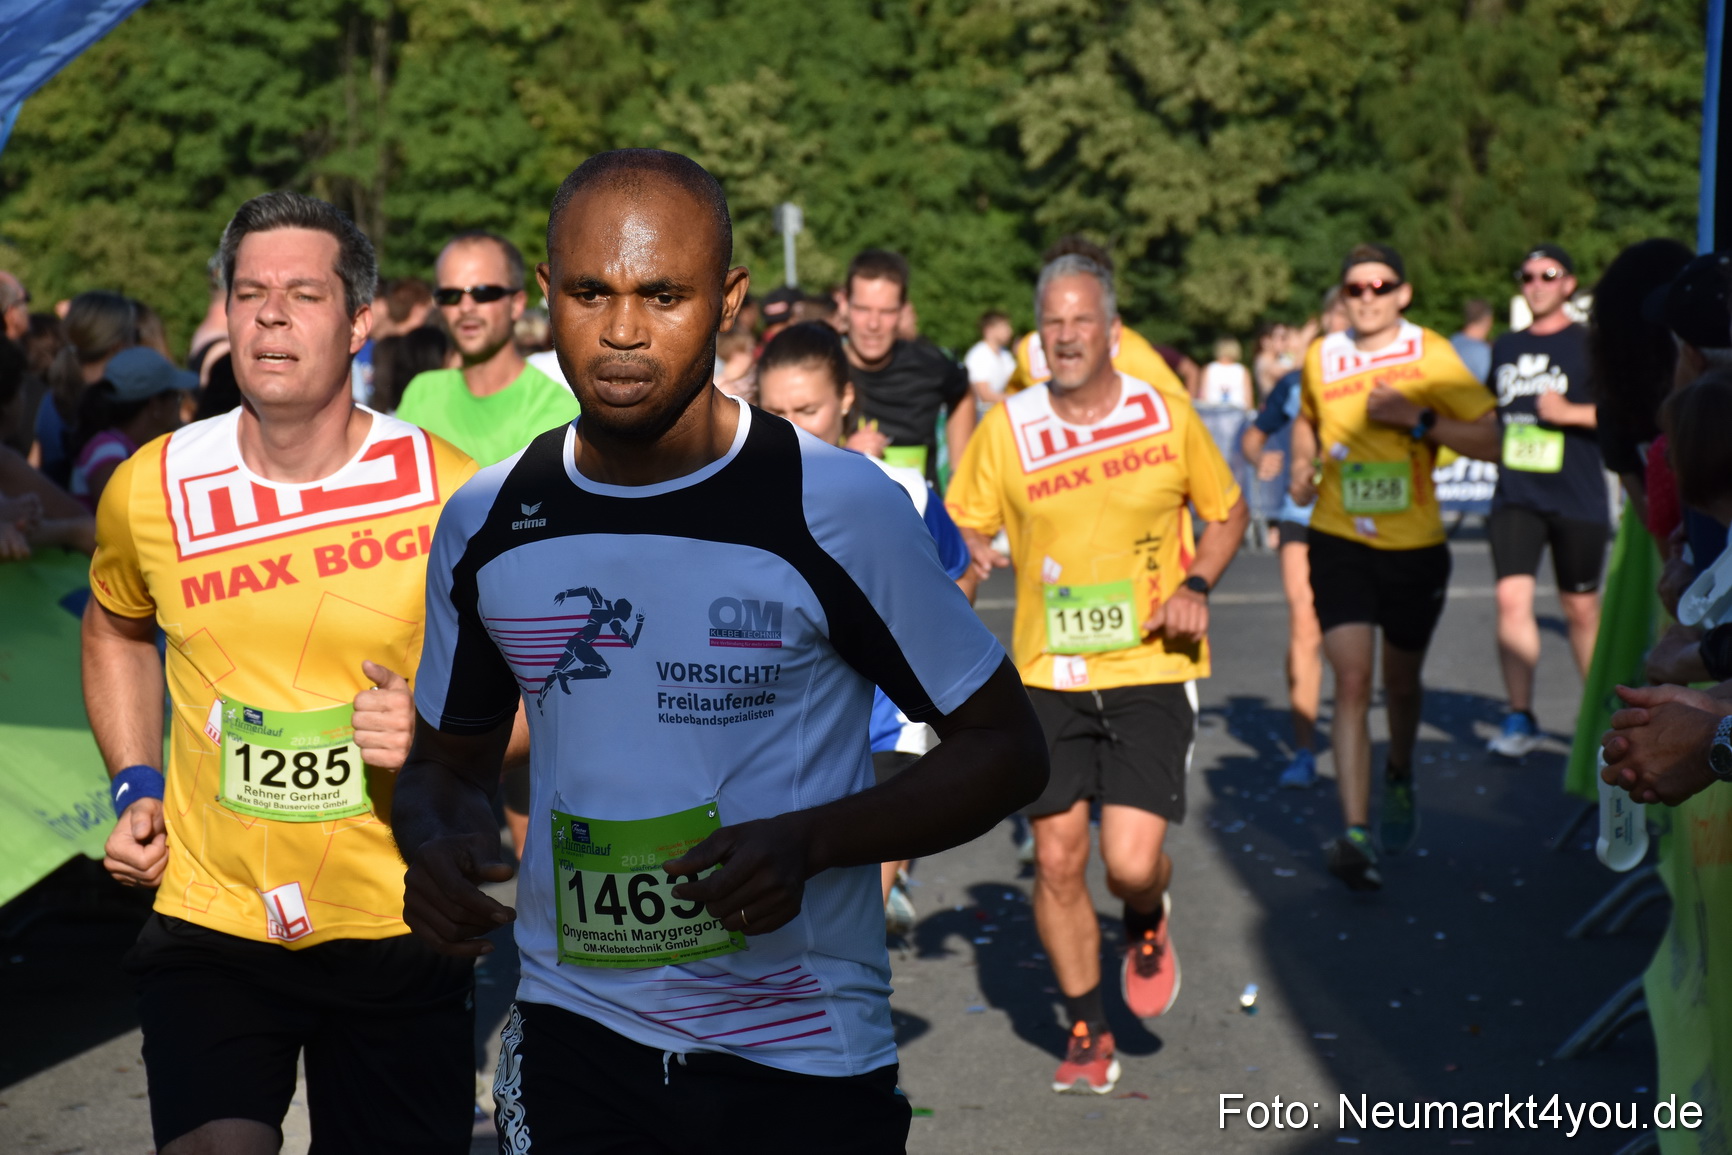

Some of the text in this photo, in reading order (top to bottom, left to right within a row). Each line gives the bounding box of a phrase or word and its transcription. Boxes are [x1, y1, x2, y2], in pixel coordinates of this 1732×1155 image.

[1027, 444, 1178, 502] MAX BÖGL
[1349, 477, 1403, 501] 1258
[511, 516, 547, 531] erima
[180, 553, 300, 608] MAX
[708, 596, 784, 631] OM
[1055, 605, 1124, 632] 1199
[710, 629, 781, 639] KLEBE TECHNIK
[656, 661, 781, 685] VORSICHT!
[657, 690, 776, 712] Freilaufende
[233, 717, 284, 738] firmenlauf
[658, 709, 775, 727] Klebebandspezialisten
[290, 735, 321, 747] 2018
[235, 743, 351, 789] 1285
[237, 794, 251, 804] Max
[253, 798, 271, 809] Bögl
[273, 802, 320, 810] Bauservice
[322, 799, 348, 808] GmbH
[244, 784, 340, 802] Rehner Gerhard
[564, 836, 613, 857] firmenlauf
[621, 853, 657, 868] 2018
[568, 870, 706, 926] 1463
[562, 923, 628, 942] Onyemachi
[583, 942, 663, 954] OM-Klebetechnik
[665, 937, 699, 951] GmbH
